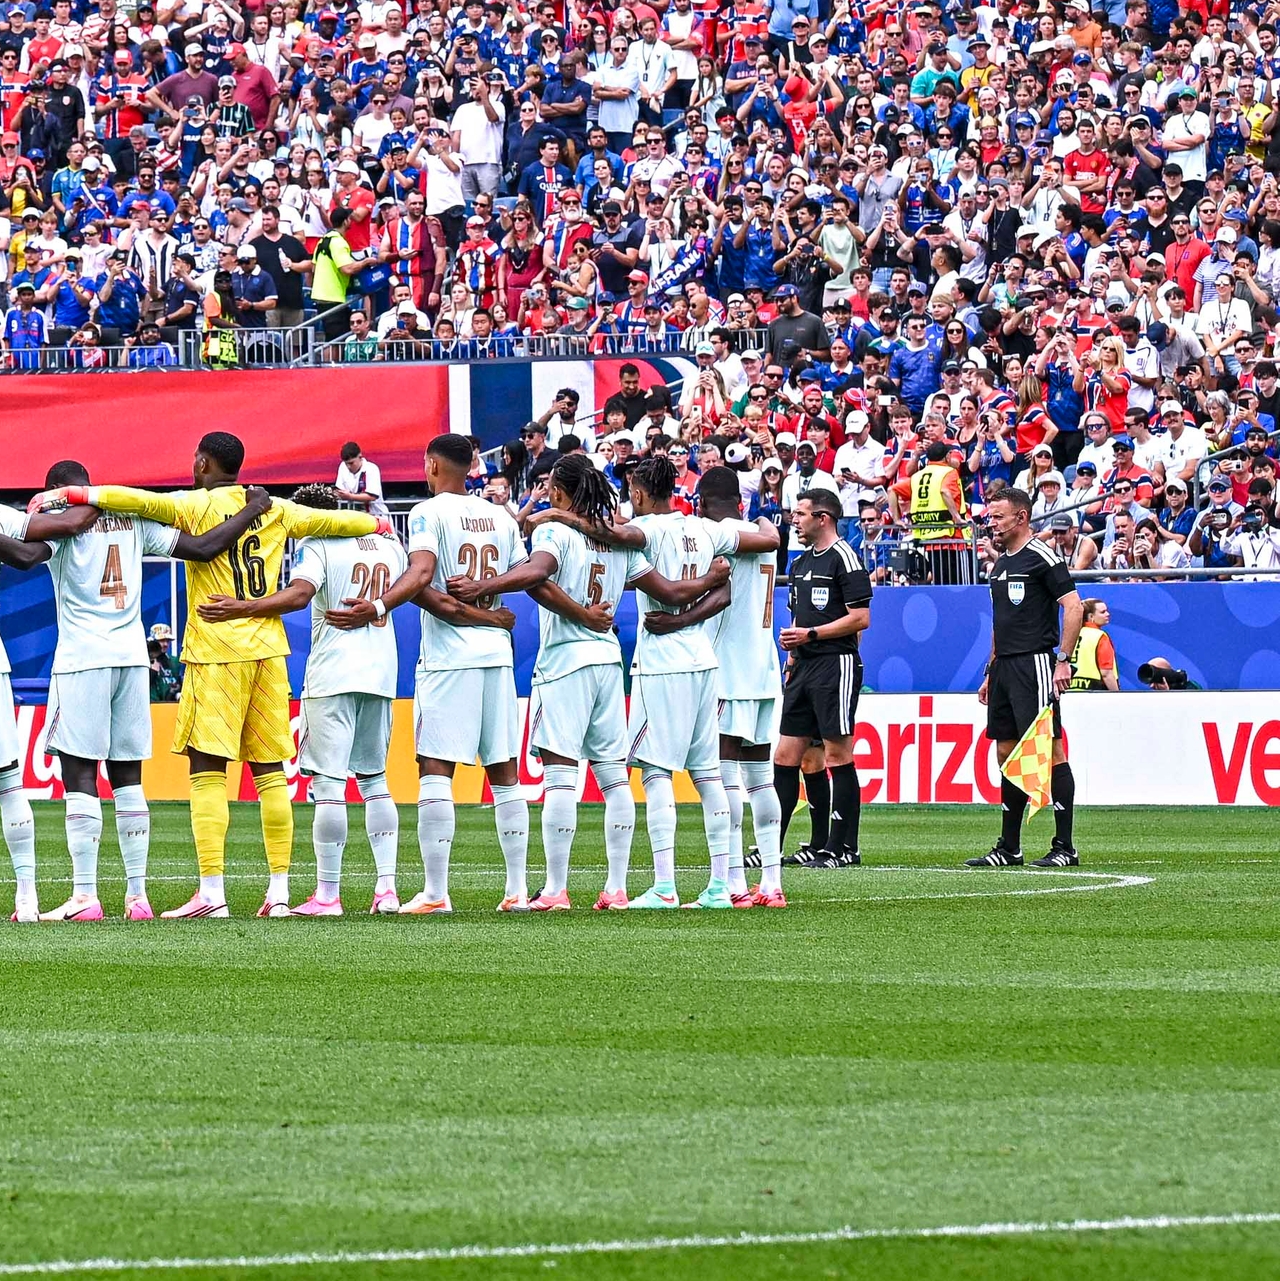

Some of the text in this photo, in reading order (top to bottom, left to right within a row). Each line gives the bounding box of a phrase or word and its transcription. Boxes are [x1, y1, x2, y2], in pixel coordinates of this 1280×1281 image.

[100, 544, 128, 609] 4
[228, 534, 268, 601] 16
[351, 562, 390, 628] 20
[458, 543, 499, 610] 26
[589, 563, 606, 607] 5
[760, 564, 775, 629] 7
[828, 696, 1068, 804] eriz
